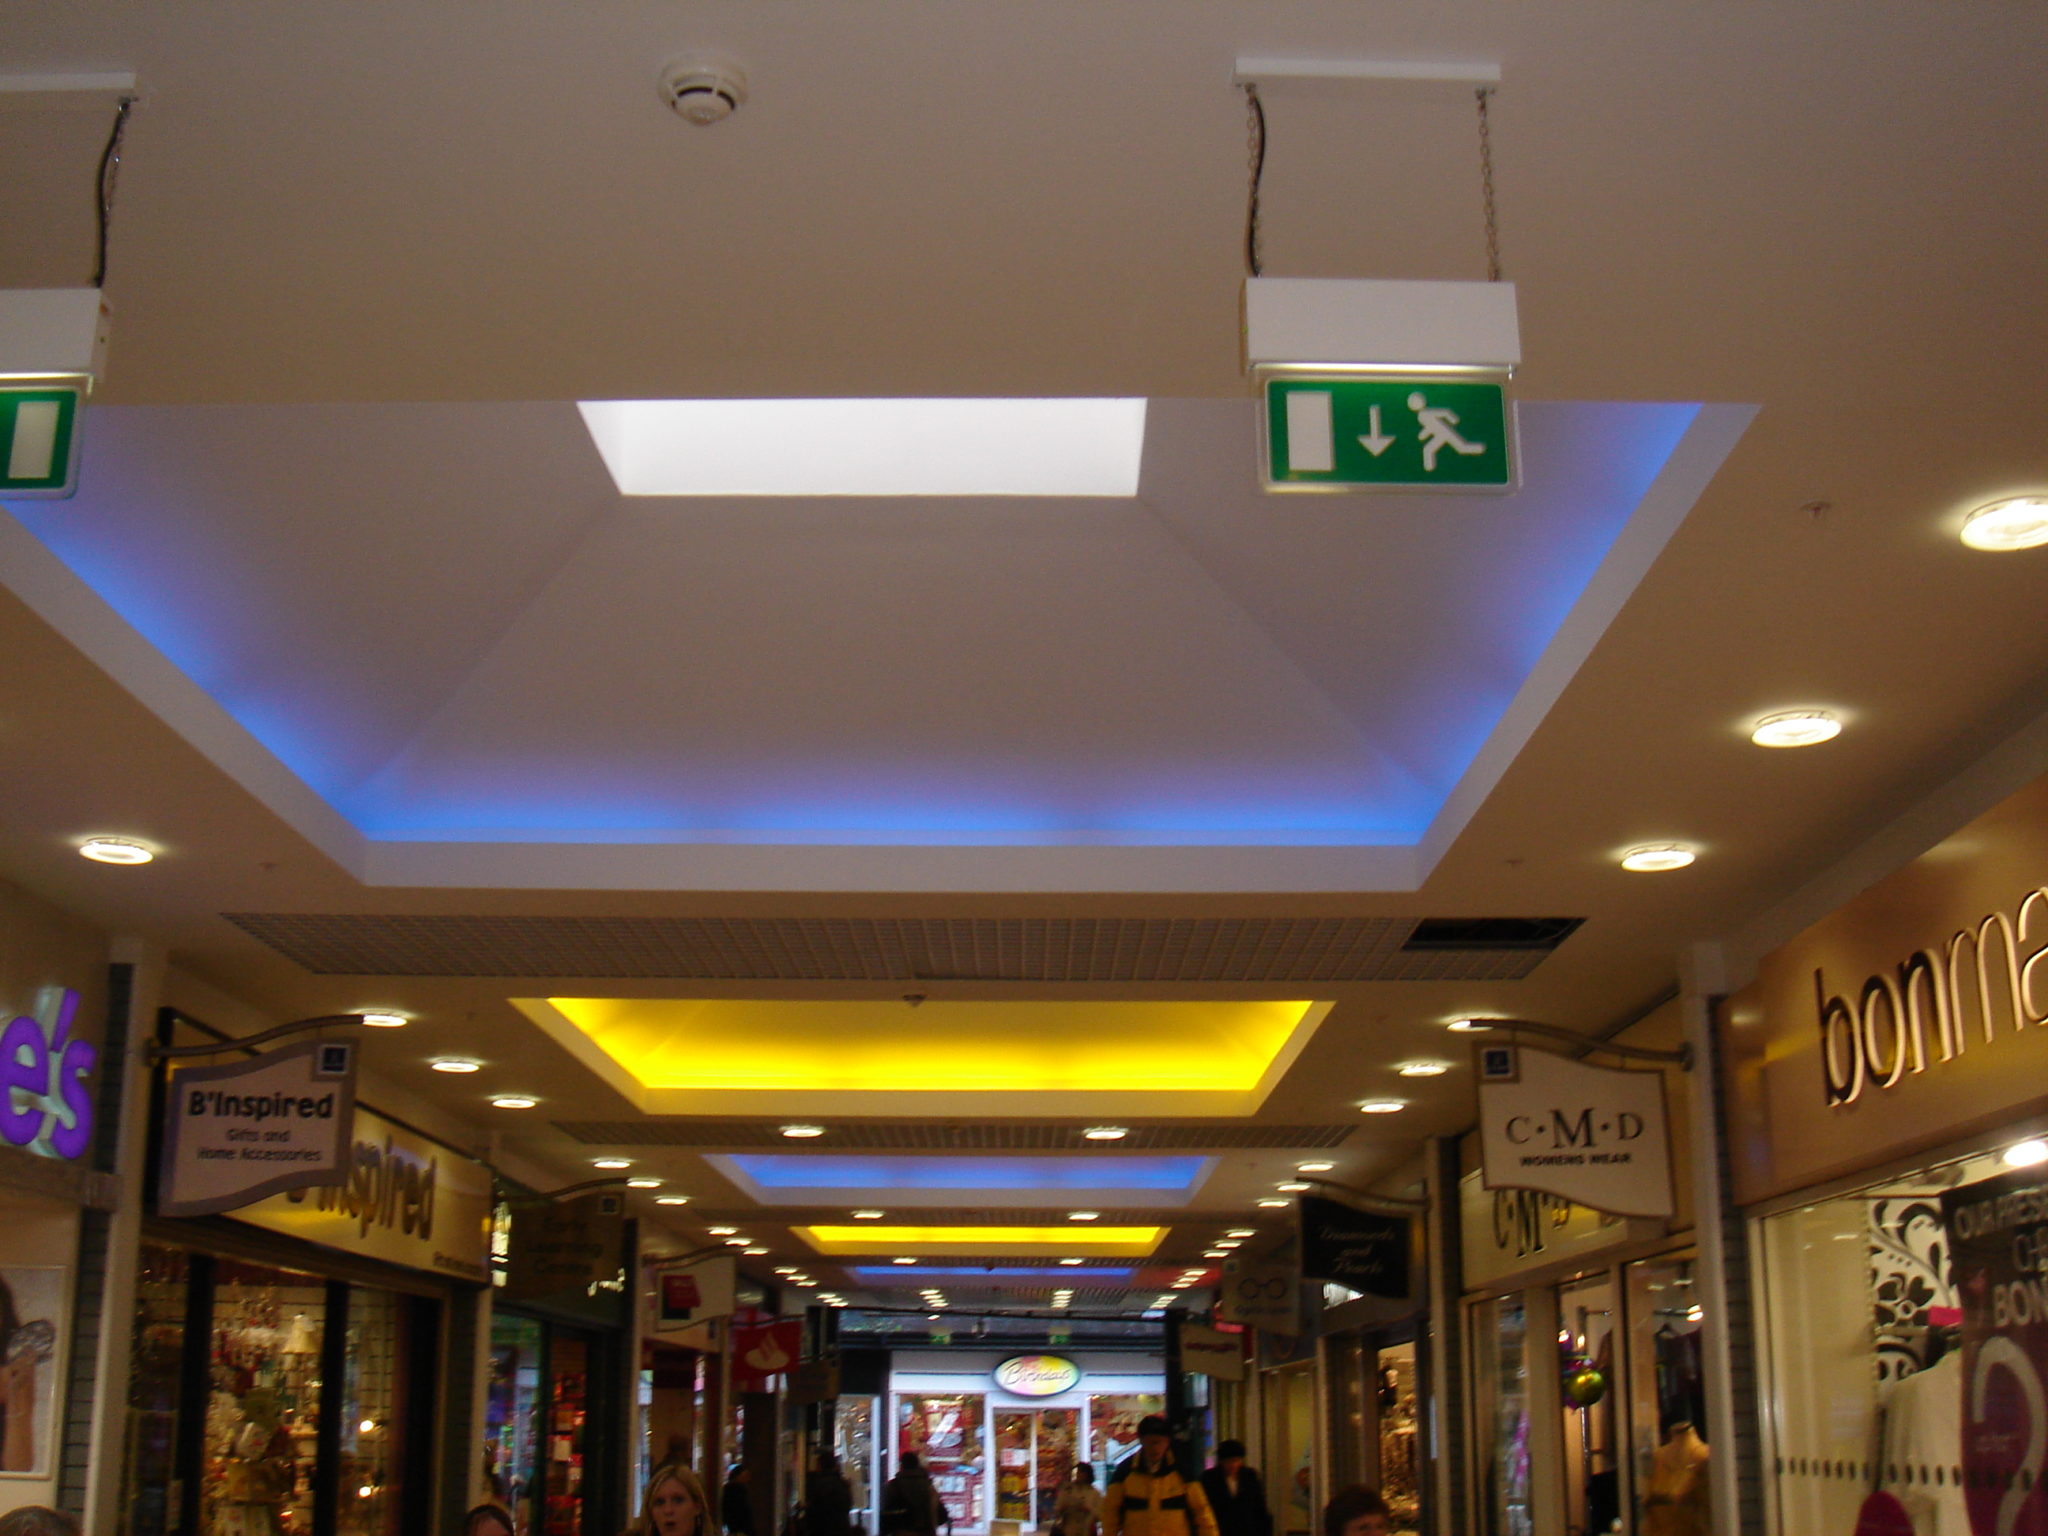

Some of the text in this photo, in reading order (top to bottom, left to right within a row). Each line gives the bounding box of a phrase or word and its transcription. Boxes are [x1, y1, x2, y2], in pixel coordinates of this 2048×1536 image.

[188, 1091, 334, 1121] B'Inspired
[226, 1129, 291, 1142] Gifts and
[197, 1147, 323, 1162] Home Accessories
[1520, 1152, 1632, 1166] WOMENS WEAR
